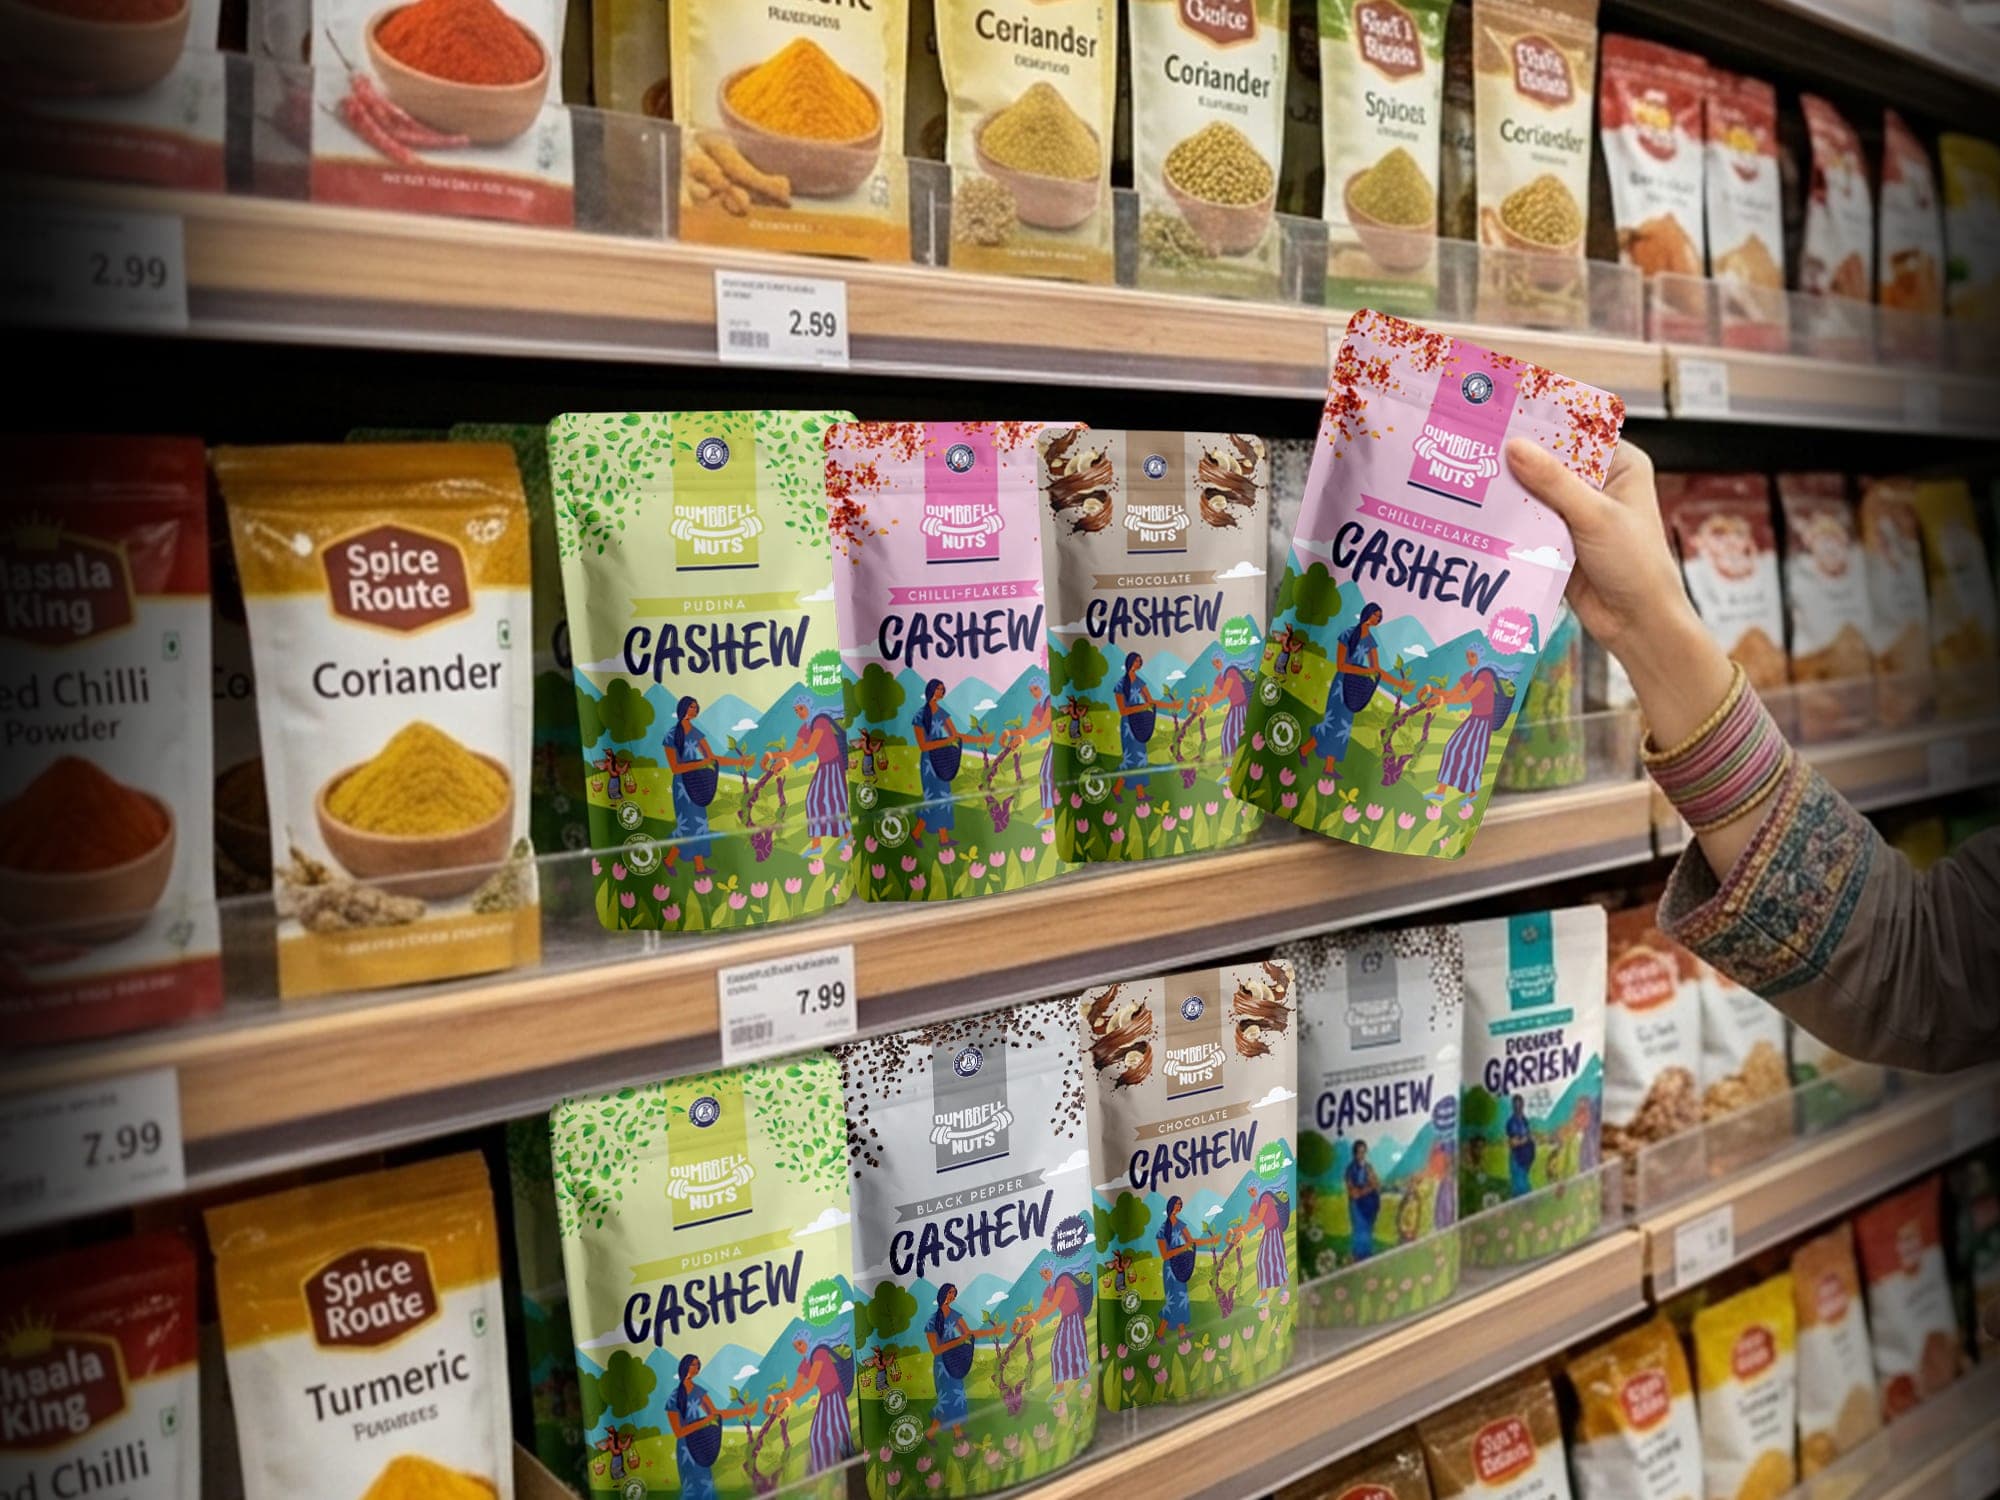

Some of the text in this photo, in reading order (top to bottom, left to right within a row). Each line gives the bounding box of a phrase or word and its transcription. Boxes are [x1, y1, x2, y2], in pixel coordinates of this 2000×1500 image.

[1165, 54, 1270, 98] Coriander
[89, 252, 167, 289] 2.99
[789, 310, 837, 337] 2.59
[1424, 424, 1496, 460] DUMBBELL
[1428, 460, 1476, 488] NUTS
[926, 504, 997, 525] DUMBBELL
[1377, 505, 1490, 550] CHILLI-FLAKES
[693, 537, 744, 555] NUTS
[942, 533, 986, 549] NUTS
[1140, 529, 1177, 543] NUTS
[1117, 574, 1191, 587] CHOCOLATE
[1332, 521, 1511, 616] CASHEW
[348, 578, 451, 612] Route
[683, 599, 746, 612] PUDINA
[908, 584, 1018, 602] CHILLI-FLAKES
[1086, 591, 1224, 645] CASHEW
[1496, 617, 1520, 631] Home
[623, 615, 810, 684] CASHEW
[878, 604, 1044, 668] CASHEW
[1491, 628, 1522, 647] Made
[53, 667, 150, 708] Chilli
[312, 653, 502, 699] Coriander
[5, 715, 121, 746] Powder
[796, 981, 846, 1015] 7.99
[1179, 1067, 1213, 1086] NUTS
[1158, 1109, 1228, 1134] CHOCOLATE
[1316, 1074, 1434, 1137] CASHEW
[83, 1121, 161, 1166] 7.99
[952, 1131, 995, 1155] NUTS
[1129, 1120, 1258, 1193] CASHEW
[689, 1186, 737, 1210] NUTS
[917, 1178, 1024, 1216] BLACK PEPPER
[890, 1189, 1054, 1279] CASHEW
[681, 1246, 742, 1269] PUDINA
[323, 1258, 413, 1307] Spice
[624, 1250, 804, 1347] CASHEW
[809, 1301, 838, 1319] Made
[305, 1348, 470, 1422] Turmeric
[52, 1439, 150, 1499] Chilli
